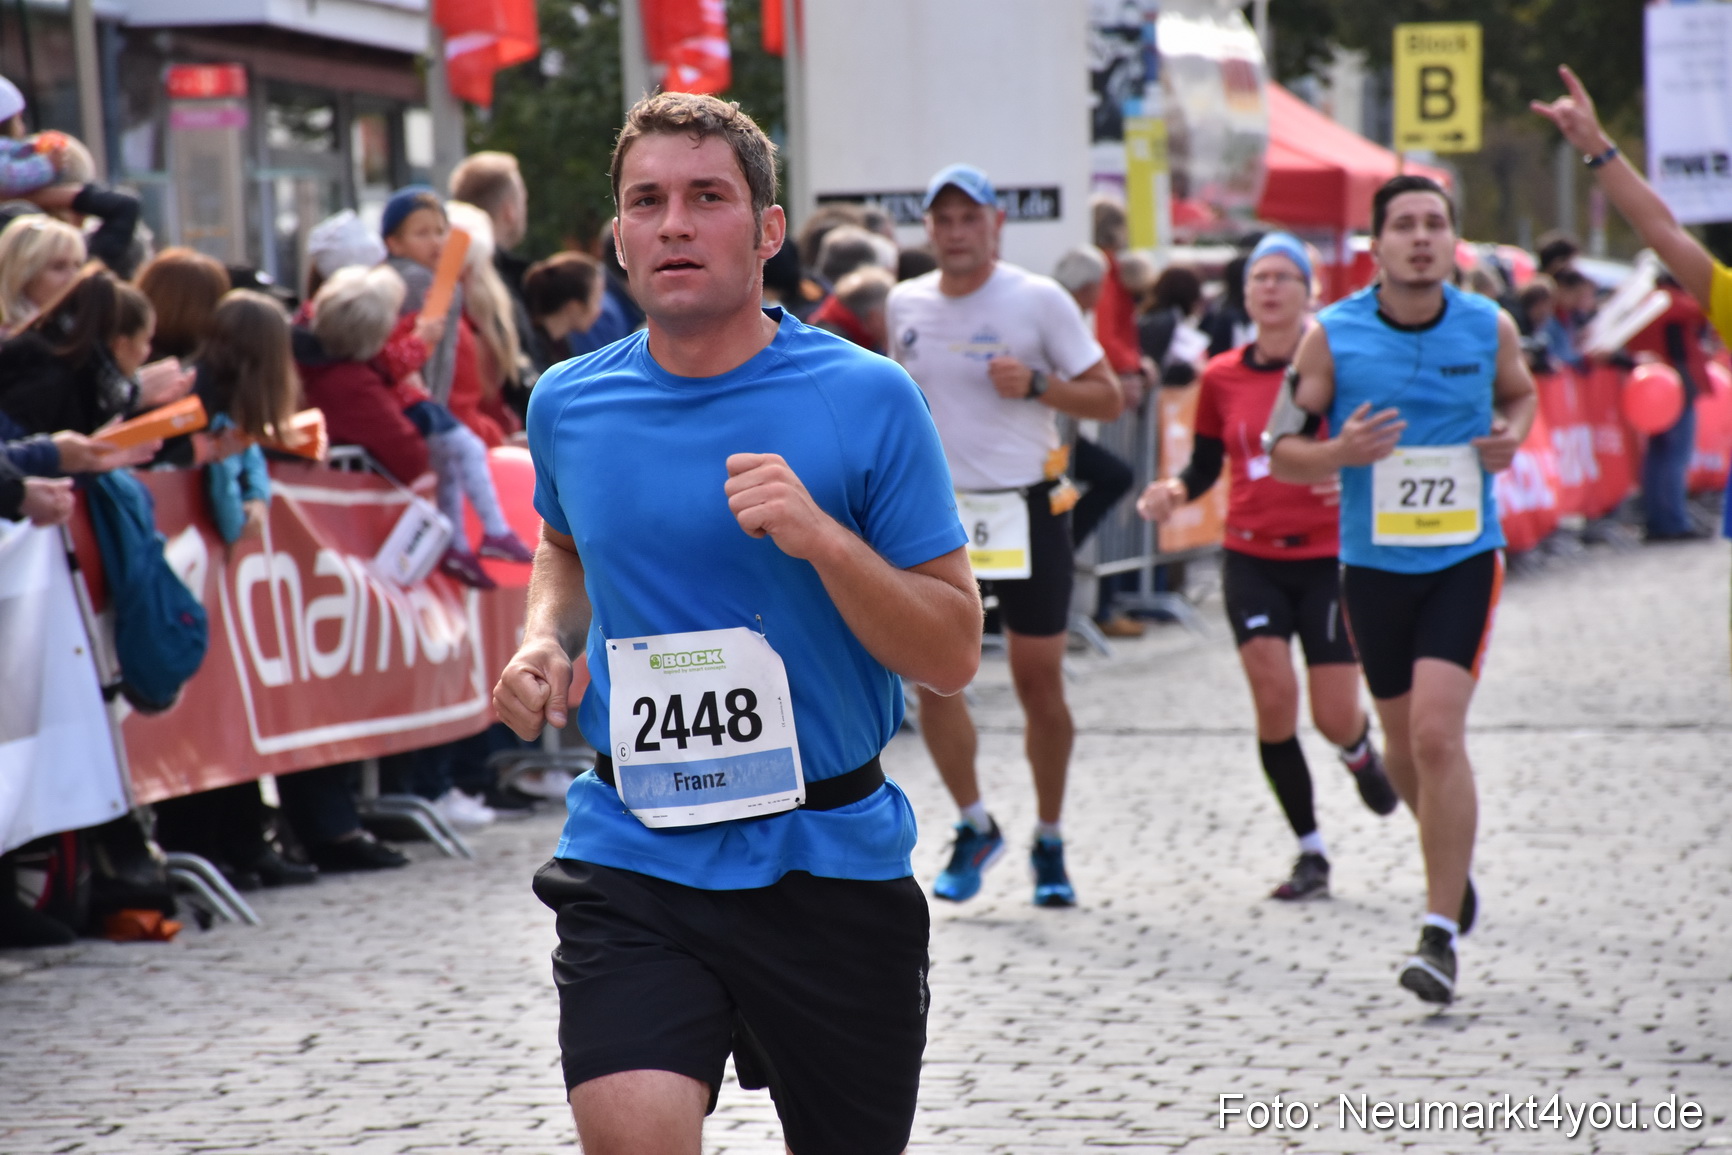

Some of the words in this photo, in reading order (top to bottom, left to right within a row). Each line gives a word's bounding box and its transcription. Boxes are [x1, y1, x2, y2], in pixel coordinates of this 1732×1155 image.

[1418, 66, 1456, 121] B
[1399, 477, 1455, 507] 272
[662, 649, 725, 669] BOCK
[632, 688, 763, 753] 2448
[673, 772, 727, 792] Franz
